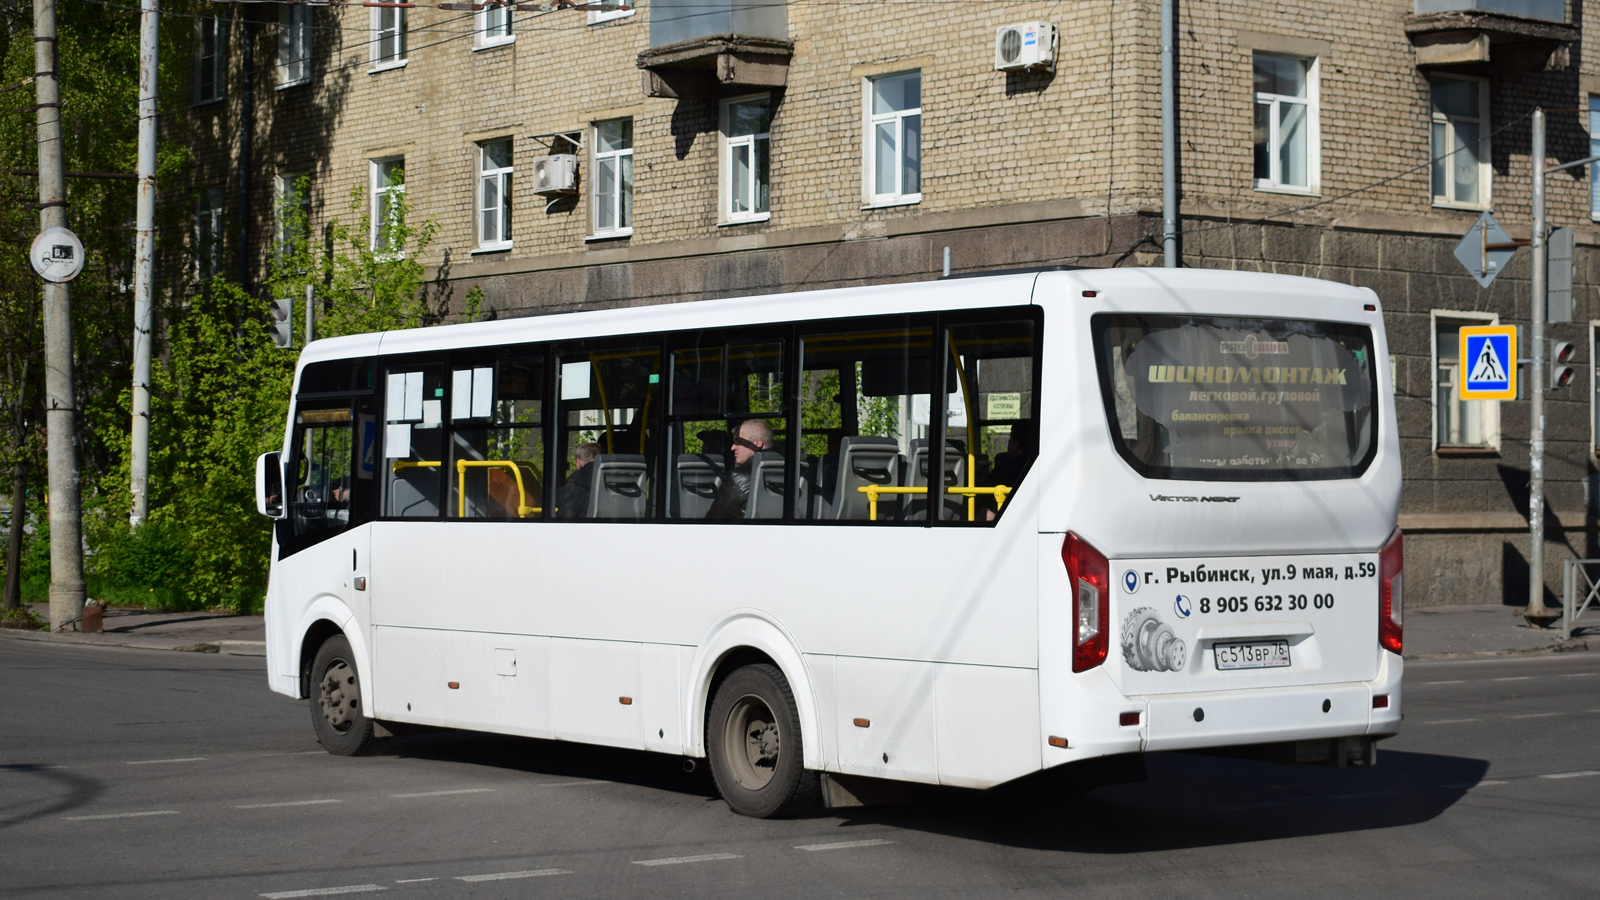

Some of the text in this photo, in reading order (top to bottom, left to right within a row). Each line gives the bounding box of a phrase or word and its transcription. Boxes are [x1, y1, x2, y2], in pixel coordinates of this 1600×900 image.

[1221, 342, 1289, 353] PRO ШИНА
[1148, 365, 1347, 386] ШИНОМОНТАЖ
[1171, 410, 1250, 423] балансировка
[1223, 426, 1262, 437] правка
[1149, 494, 1199, 502] VECTOR
[1144, 572, 1159, 584] г.
[1166, 564, 1255, 584] Рыбинск,
[1302, 565, 1339, 581] мая,
[1199, 593, 1334, 614] 8 905 632 30 00
[1272, 643, 1284, 655] 76
